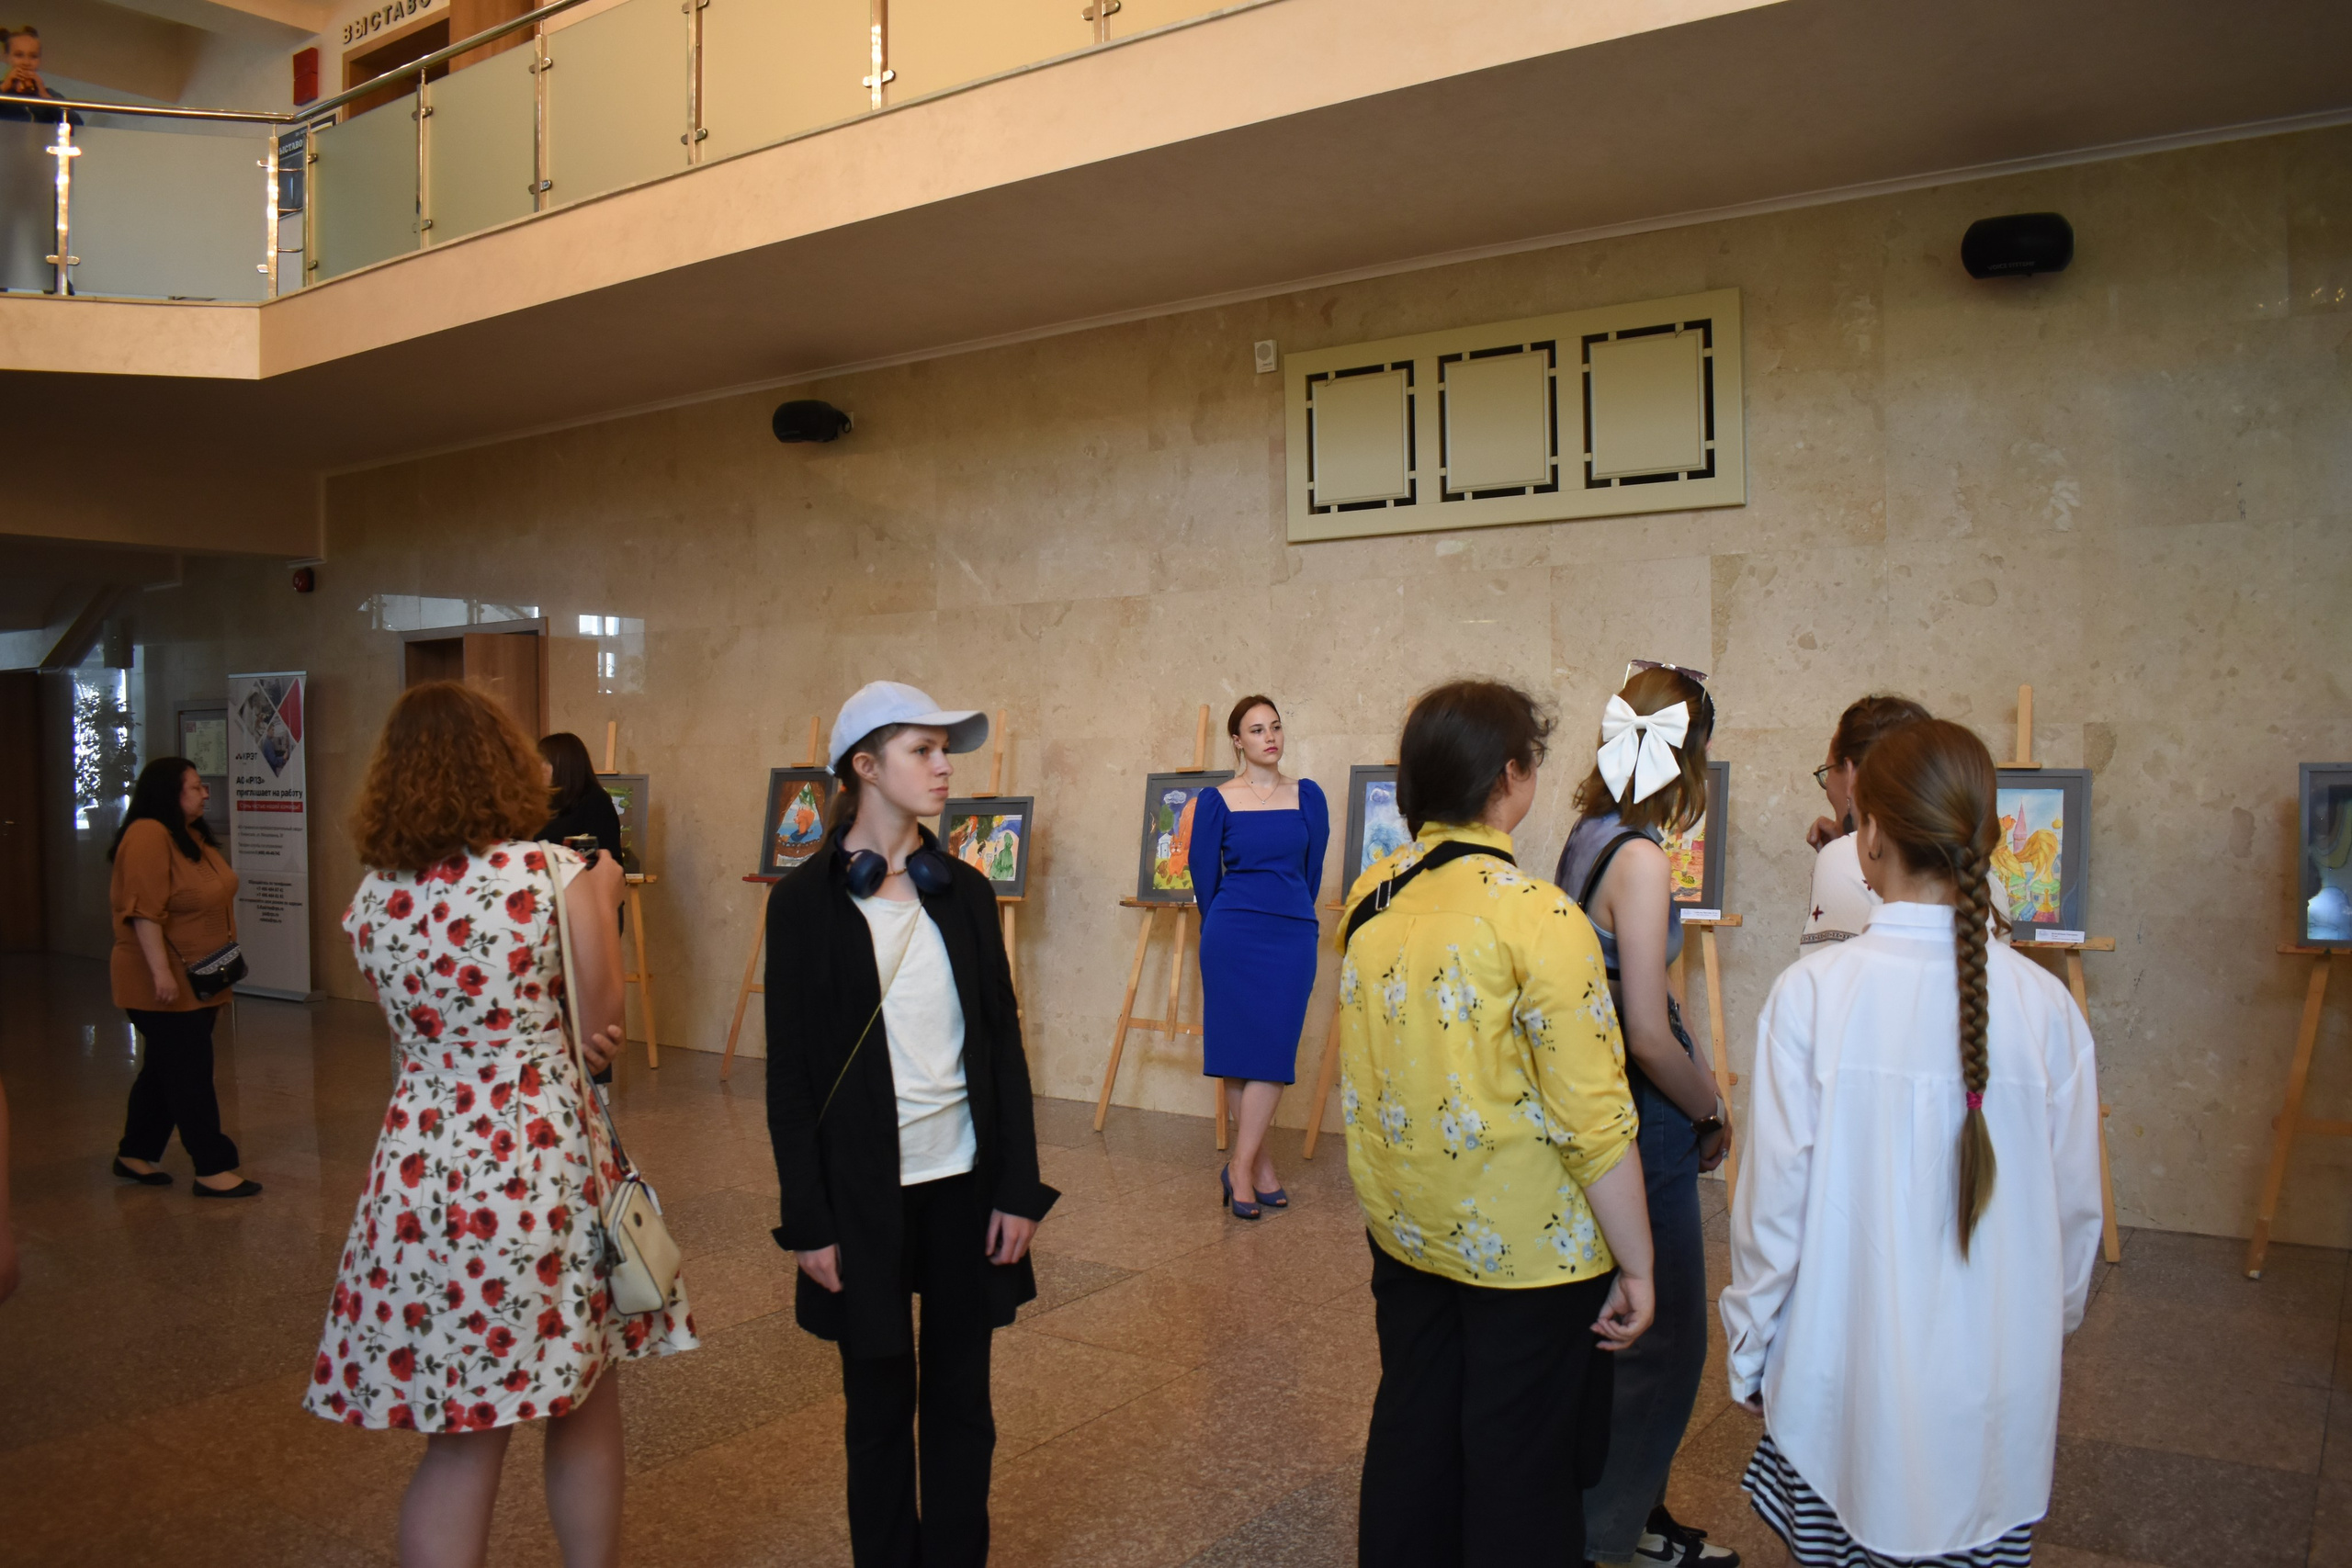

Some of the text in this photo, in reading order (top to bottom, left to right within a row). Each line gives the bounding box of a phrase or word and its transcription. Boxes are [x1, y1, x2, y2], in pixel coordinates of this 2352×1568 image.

[278, 139, 303, 155] ЫСТАВО
[236, 776, 245, 784] АО
[236, 789, 271, 798] приглашает
[280, 788, 303, 799] работу
